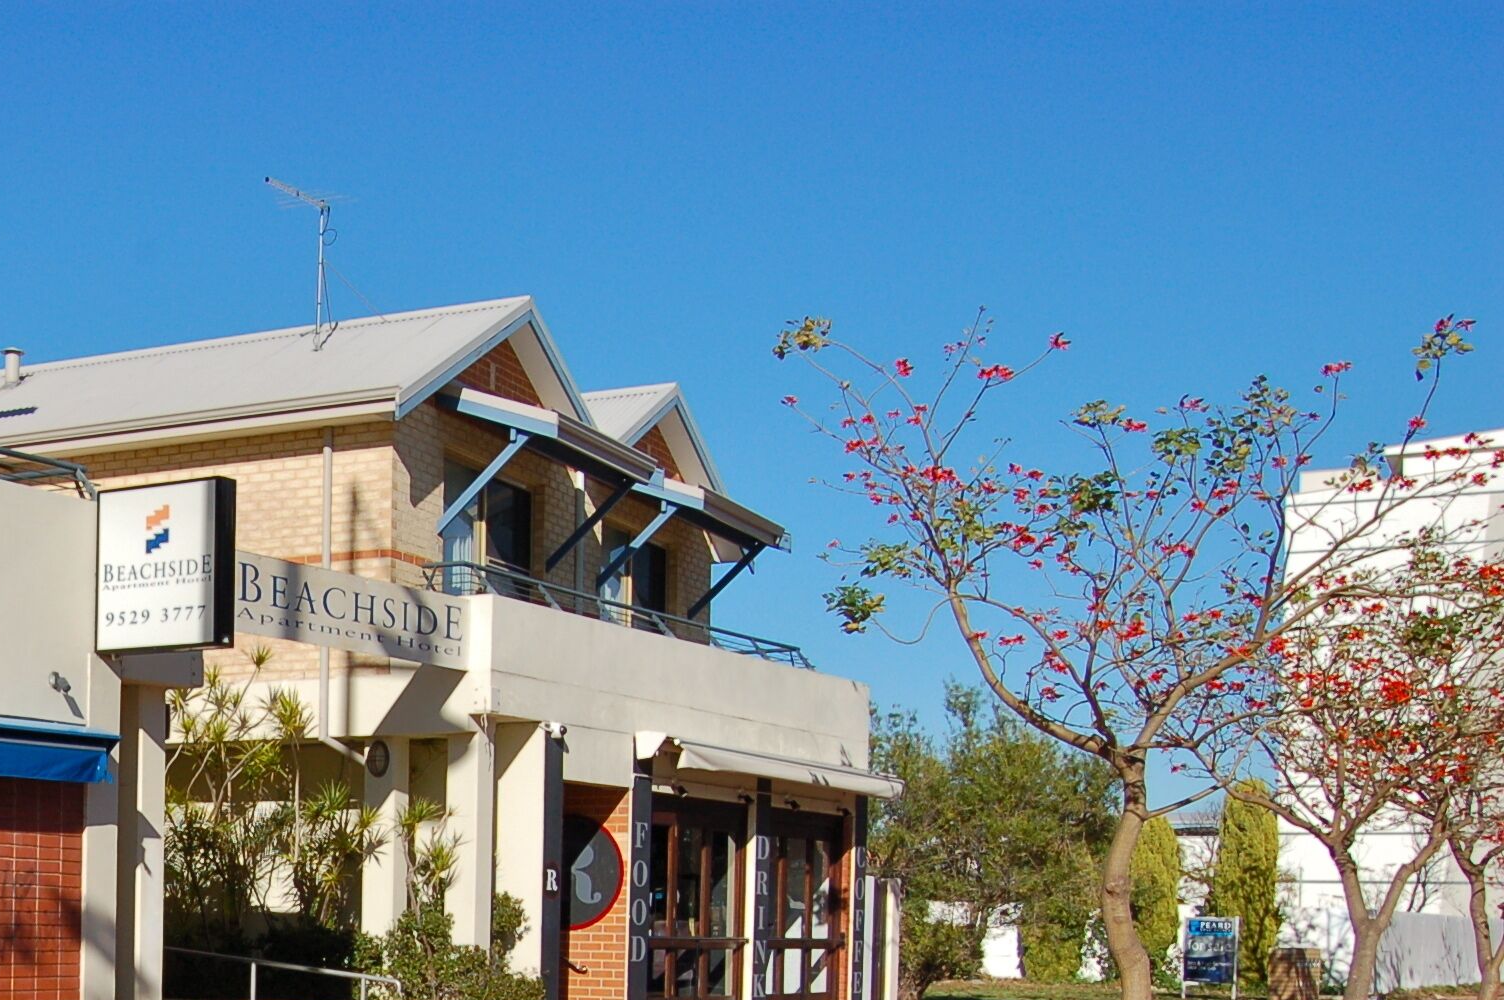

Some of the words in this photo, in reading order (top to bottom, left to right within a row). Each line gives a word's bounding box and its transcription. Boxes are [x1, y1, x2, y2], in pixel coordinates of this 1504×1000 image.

[104, 553, 213, 583] BEACHSIDE
[103, 580, 170, 592] Apartment
[176, 574, 212, 585] Hotel
[238, 562, 463, 642] BEACHSIDE
[105, 608, 151, 627] 9529
[160, 604, 206, 623] 3777
[237, 607, 385, 644] Apartment
[397, 635, 462, 657] Hotel
[546, 869, 558, 892] R
[630, 821, 649, 963] FOOD
[1200, 921, 1232, 930] PEARD
